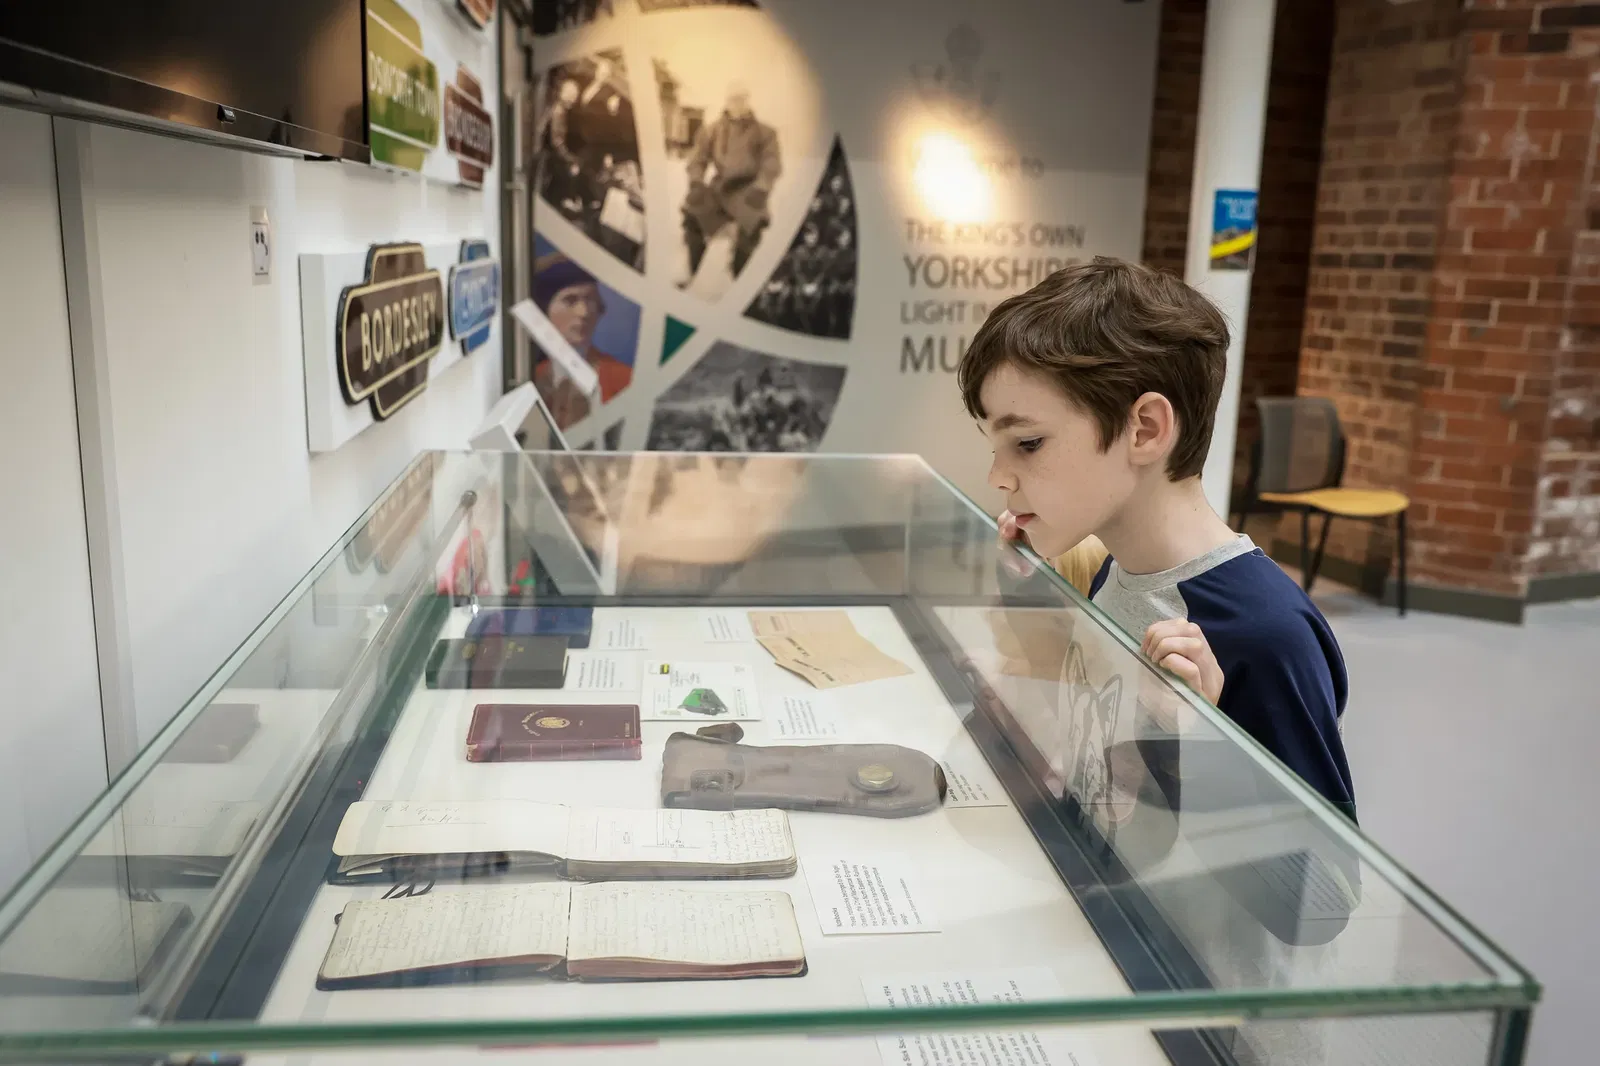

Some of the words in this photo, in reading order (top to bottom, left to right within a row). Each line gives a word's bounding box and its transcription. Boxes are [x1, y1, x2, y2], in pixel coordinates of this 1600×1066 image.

[1029, 223, 1086, 248] OWN
[902, 254, 1082, 289] YORKSHI
[900, 300, 966, 325] LIGHT
[360, 291, 437, 371] BORDESLEY
